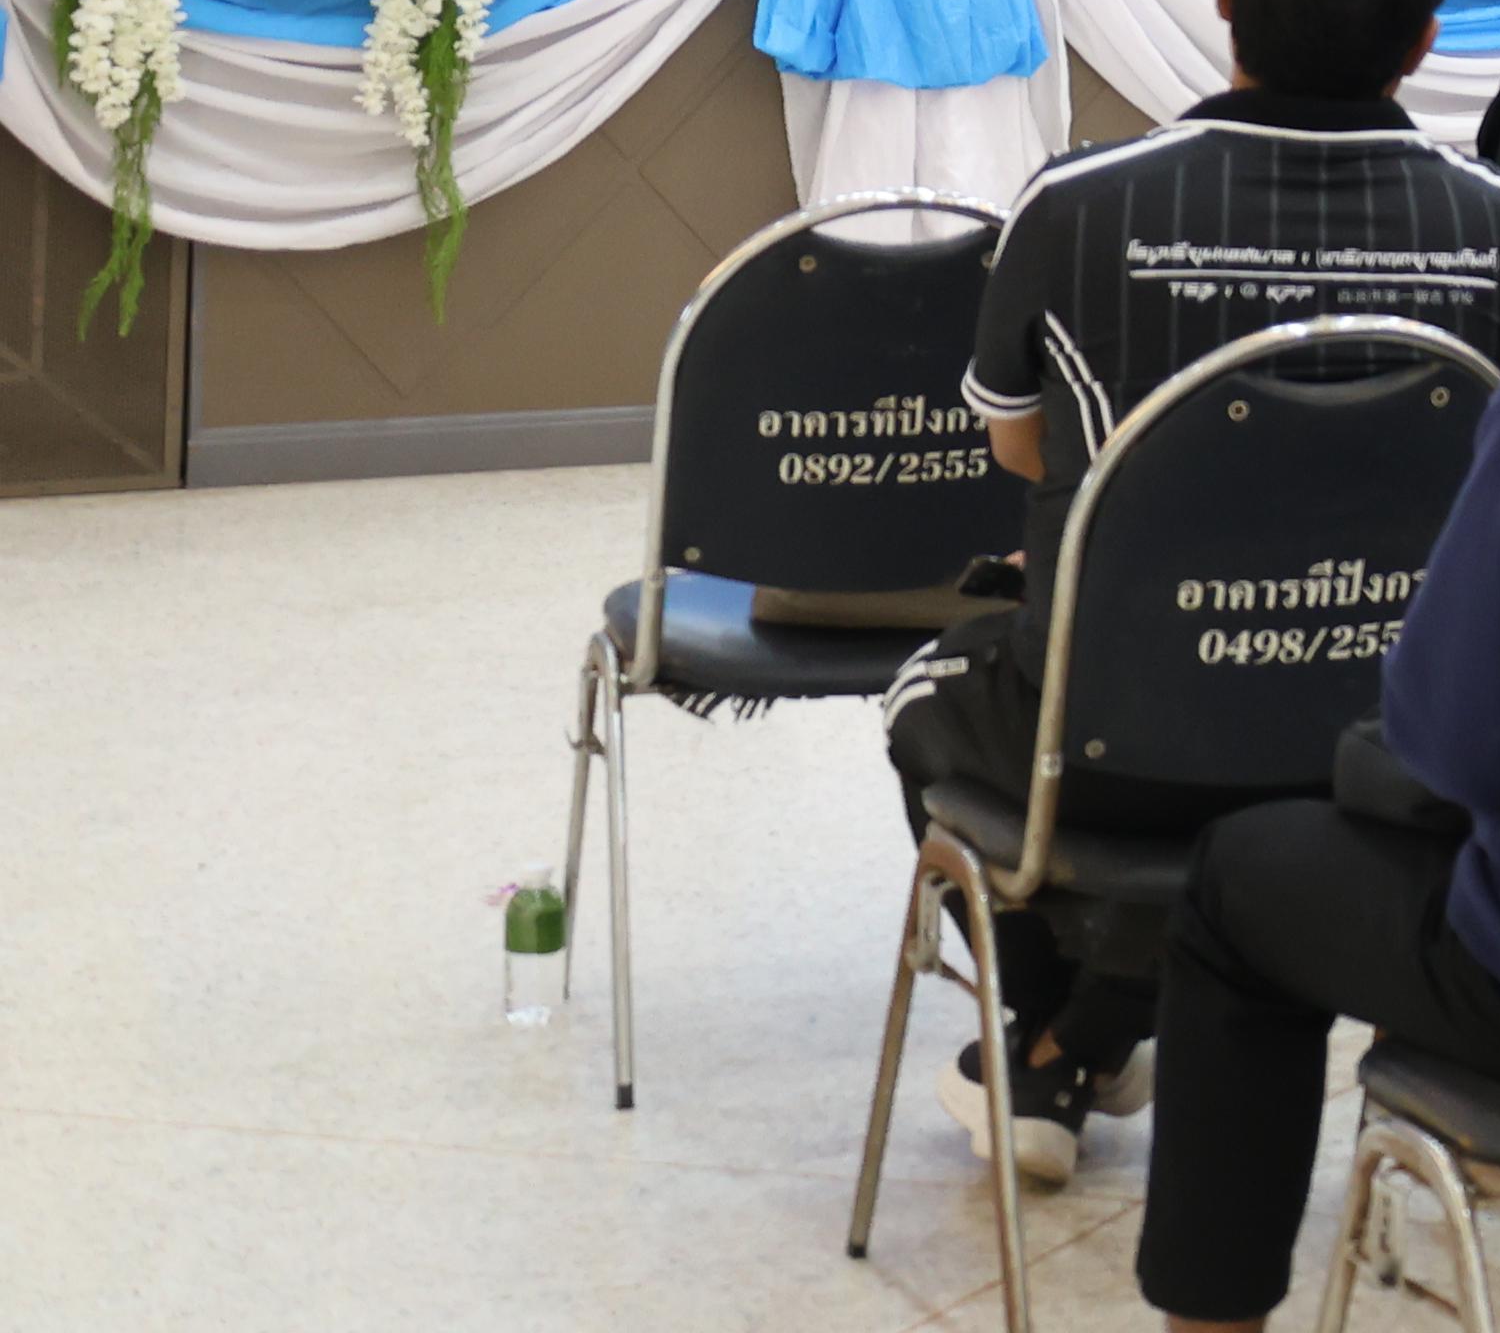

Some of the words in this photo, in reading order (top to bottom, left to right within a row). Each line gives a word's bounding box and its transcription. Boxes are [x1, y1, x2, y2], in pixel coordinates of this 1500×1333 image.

[758, 394, 988, 439] อาคารทีปังกร
[778, 447, 990, 487] 0892/2555
[1197, 619, 1405, 666] 0498/255
